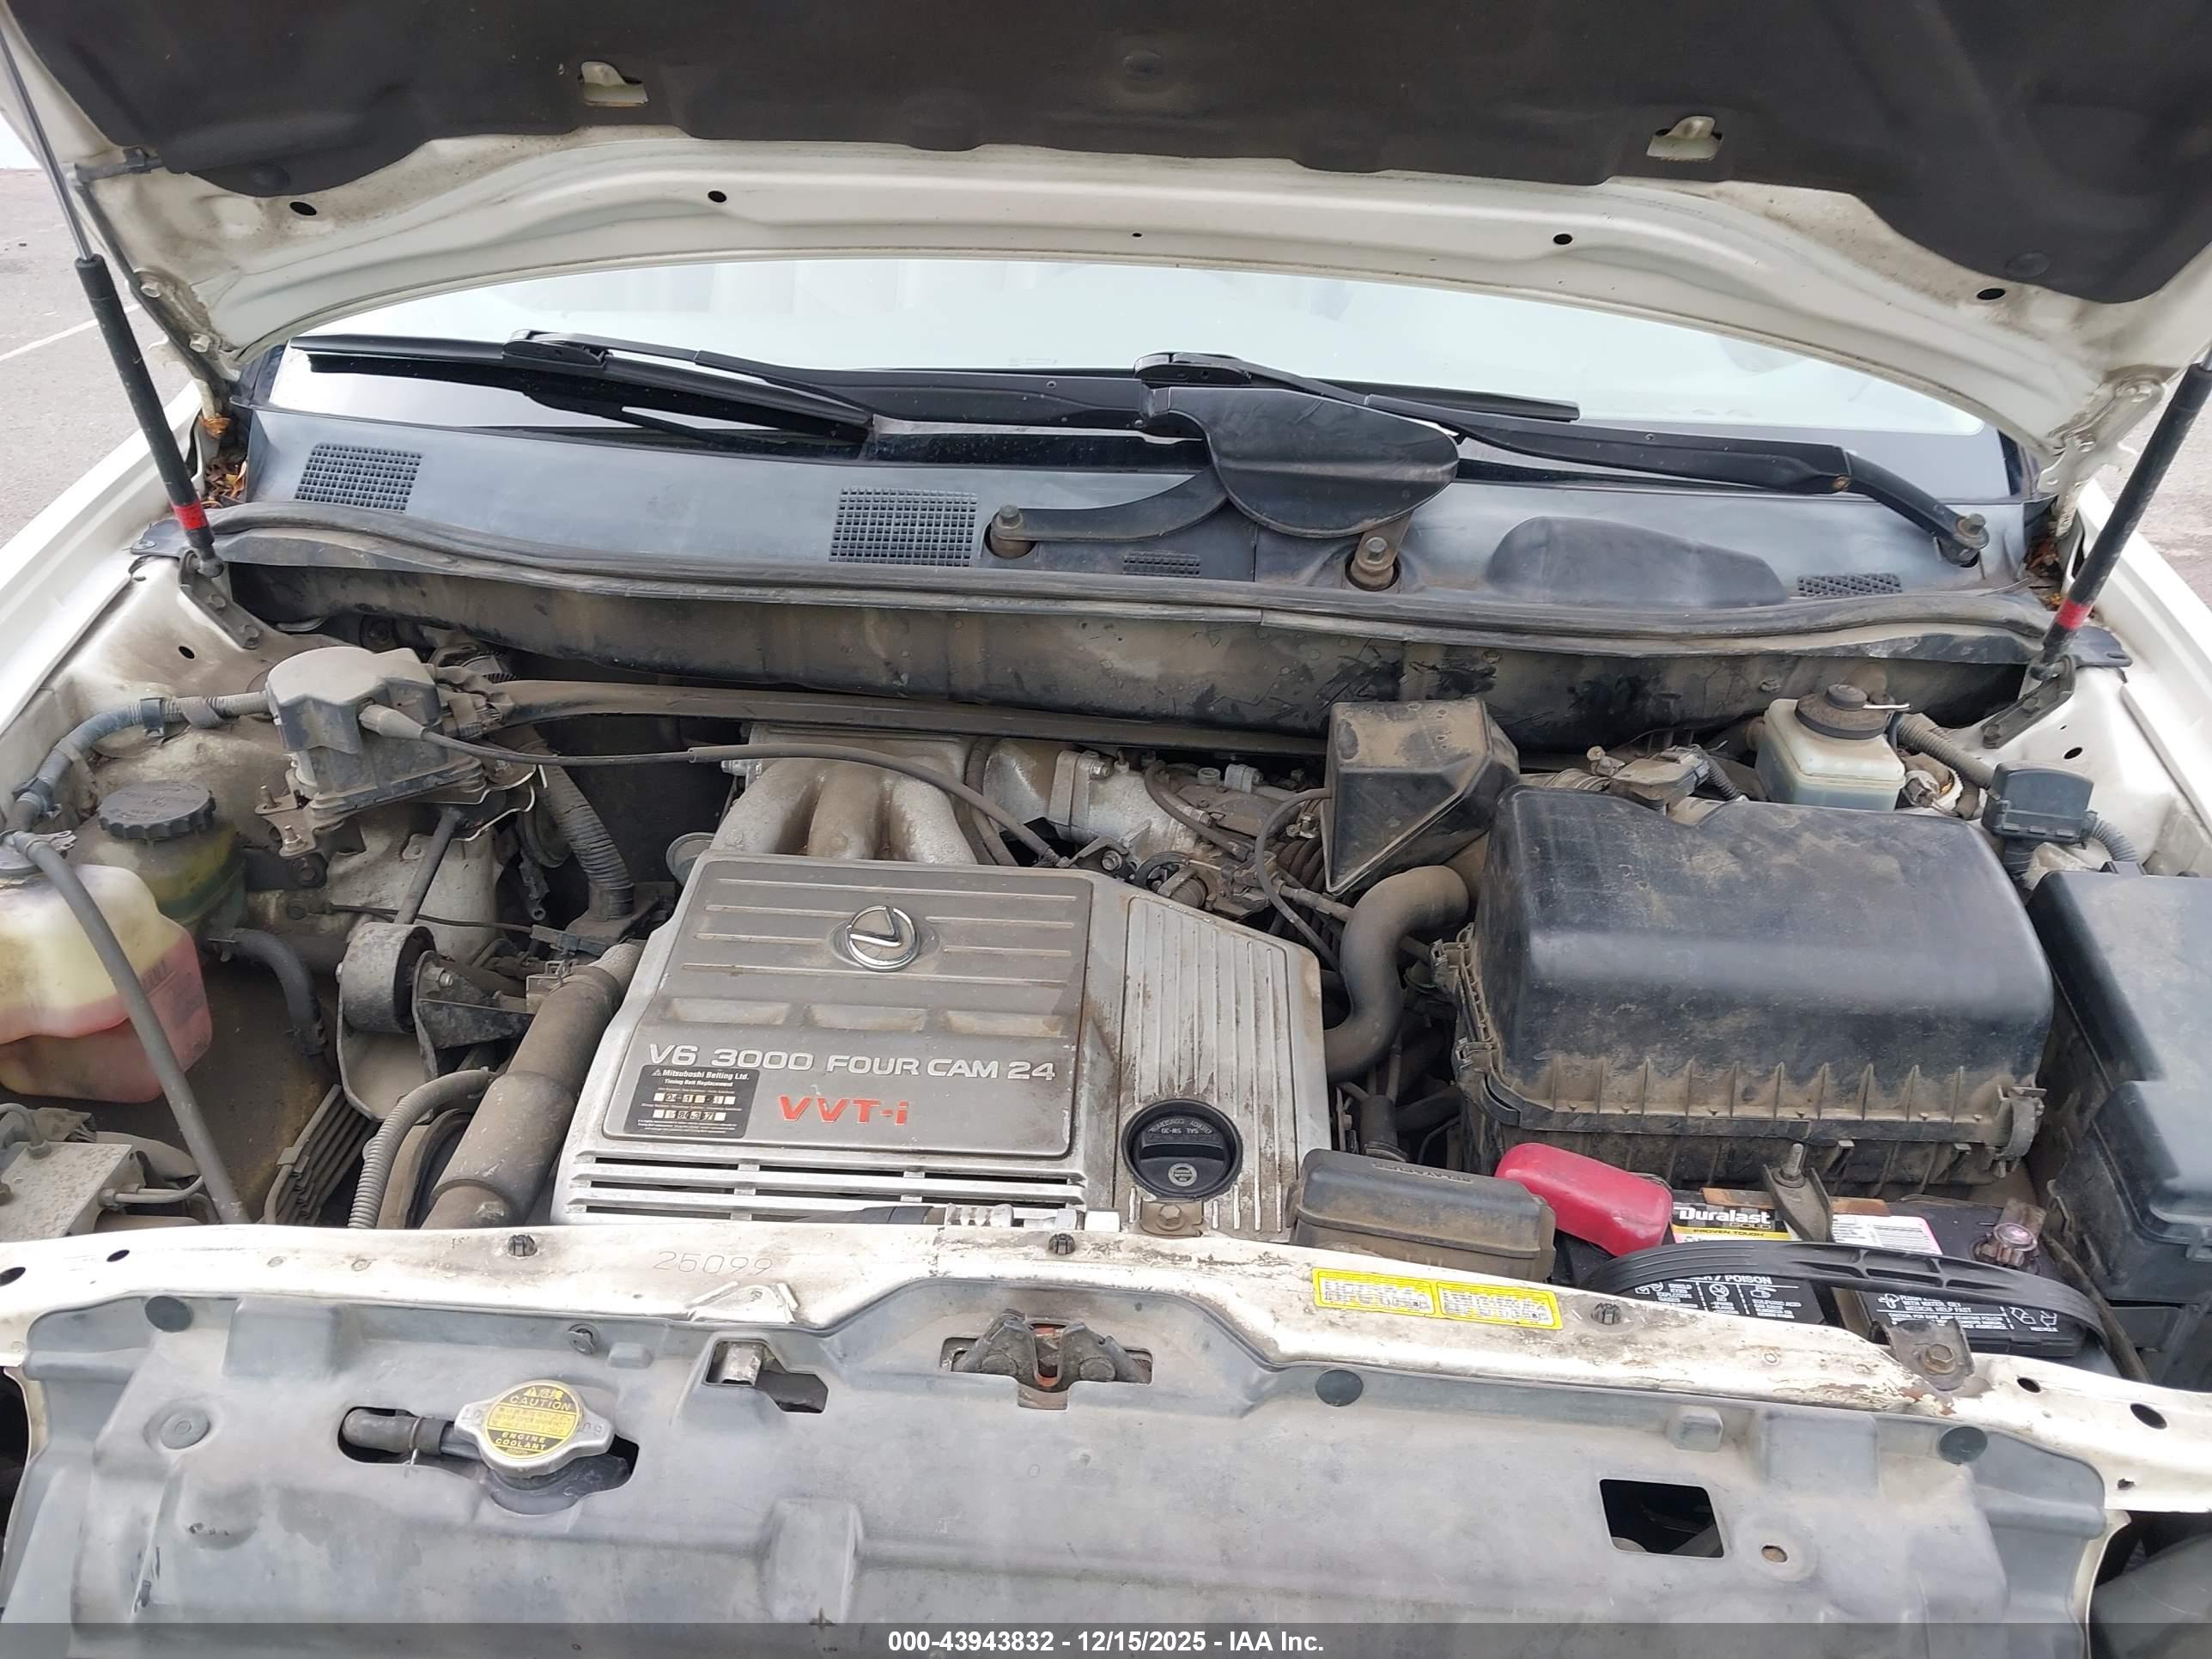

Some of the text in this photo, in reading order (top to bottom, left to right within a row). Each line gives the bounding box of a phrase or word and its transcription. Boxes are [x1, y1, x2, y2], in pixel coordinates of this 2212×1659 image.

[649, 1044, 1056, 1081] V6 3000 FOUR CAM 24
[706, 1071, 733, 1080] Belting
[777, 1095, 909, 1126] VVT-i
[1673, 1206, 1771, 1224] Duralast
[653, 1250, 774, 1276] 25099
[1723, 1275, 1772, 1285] POISON
[509, 1395, 571, 1411] CAUTION
[495, 1437, 546, 1450] COOLANT
[501, 1431, 547, 1443] ENGINE
